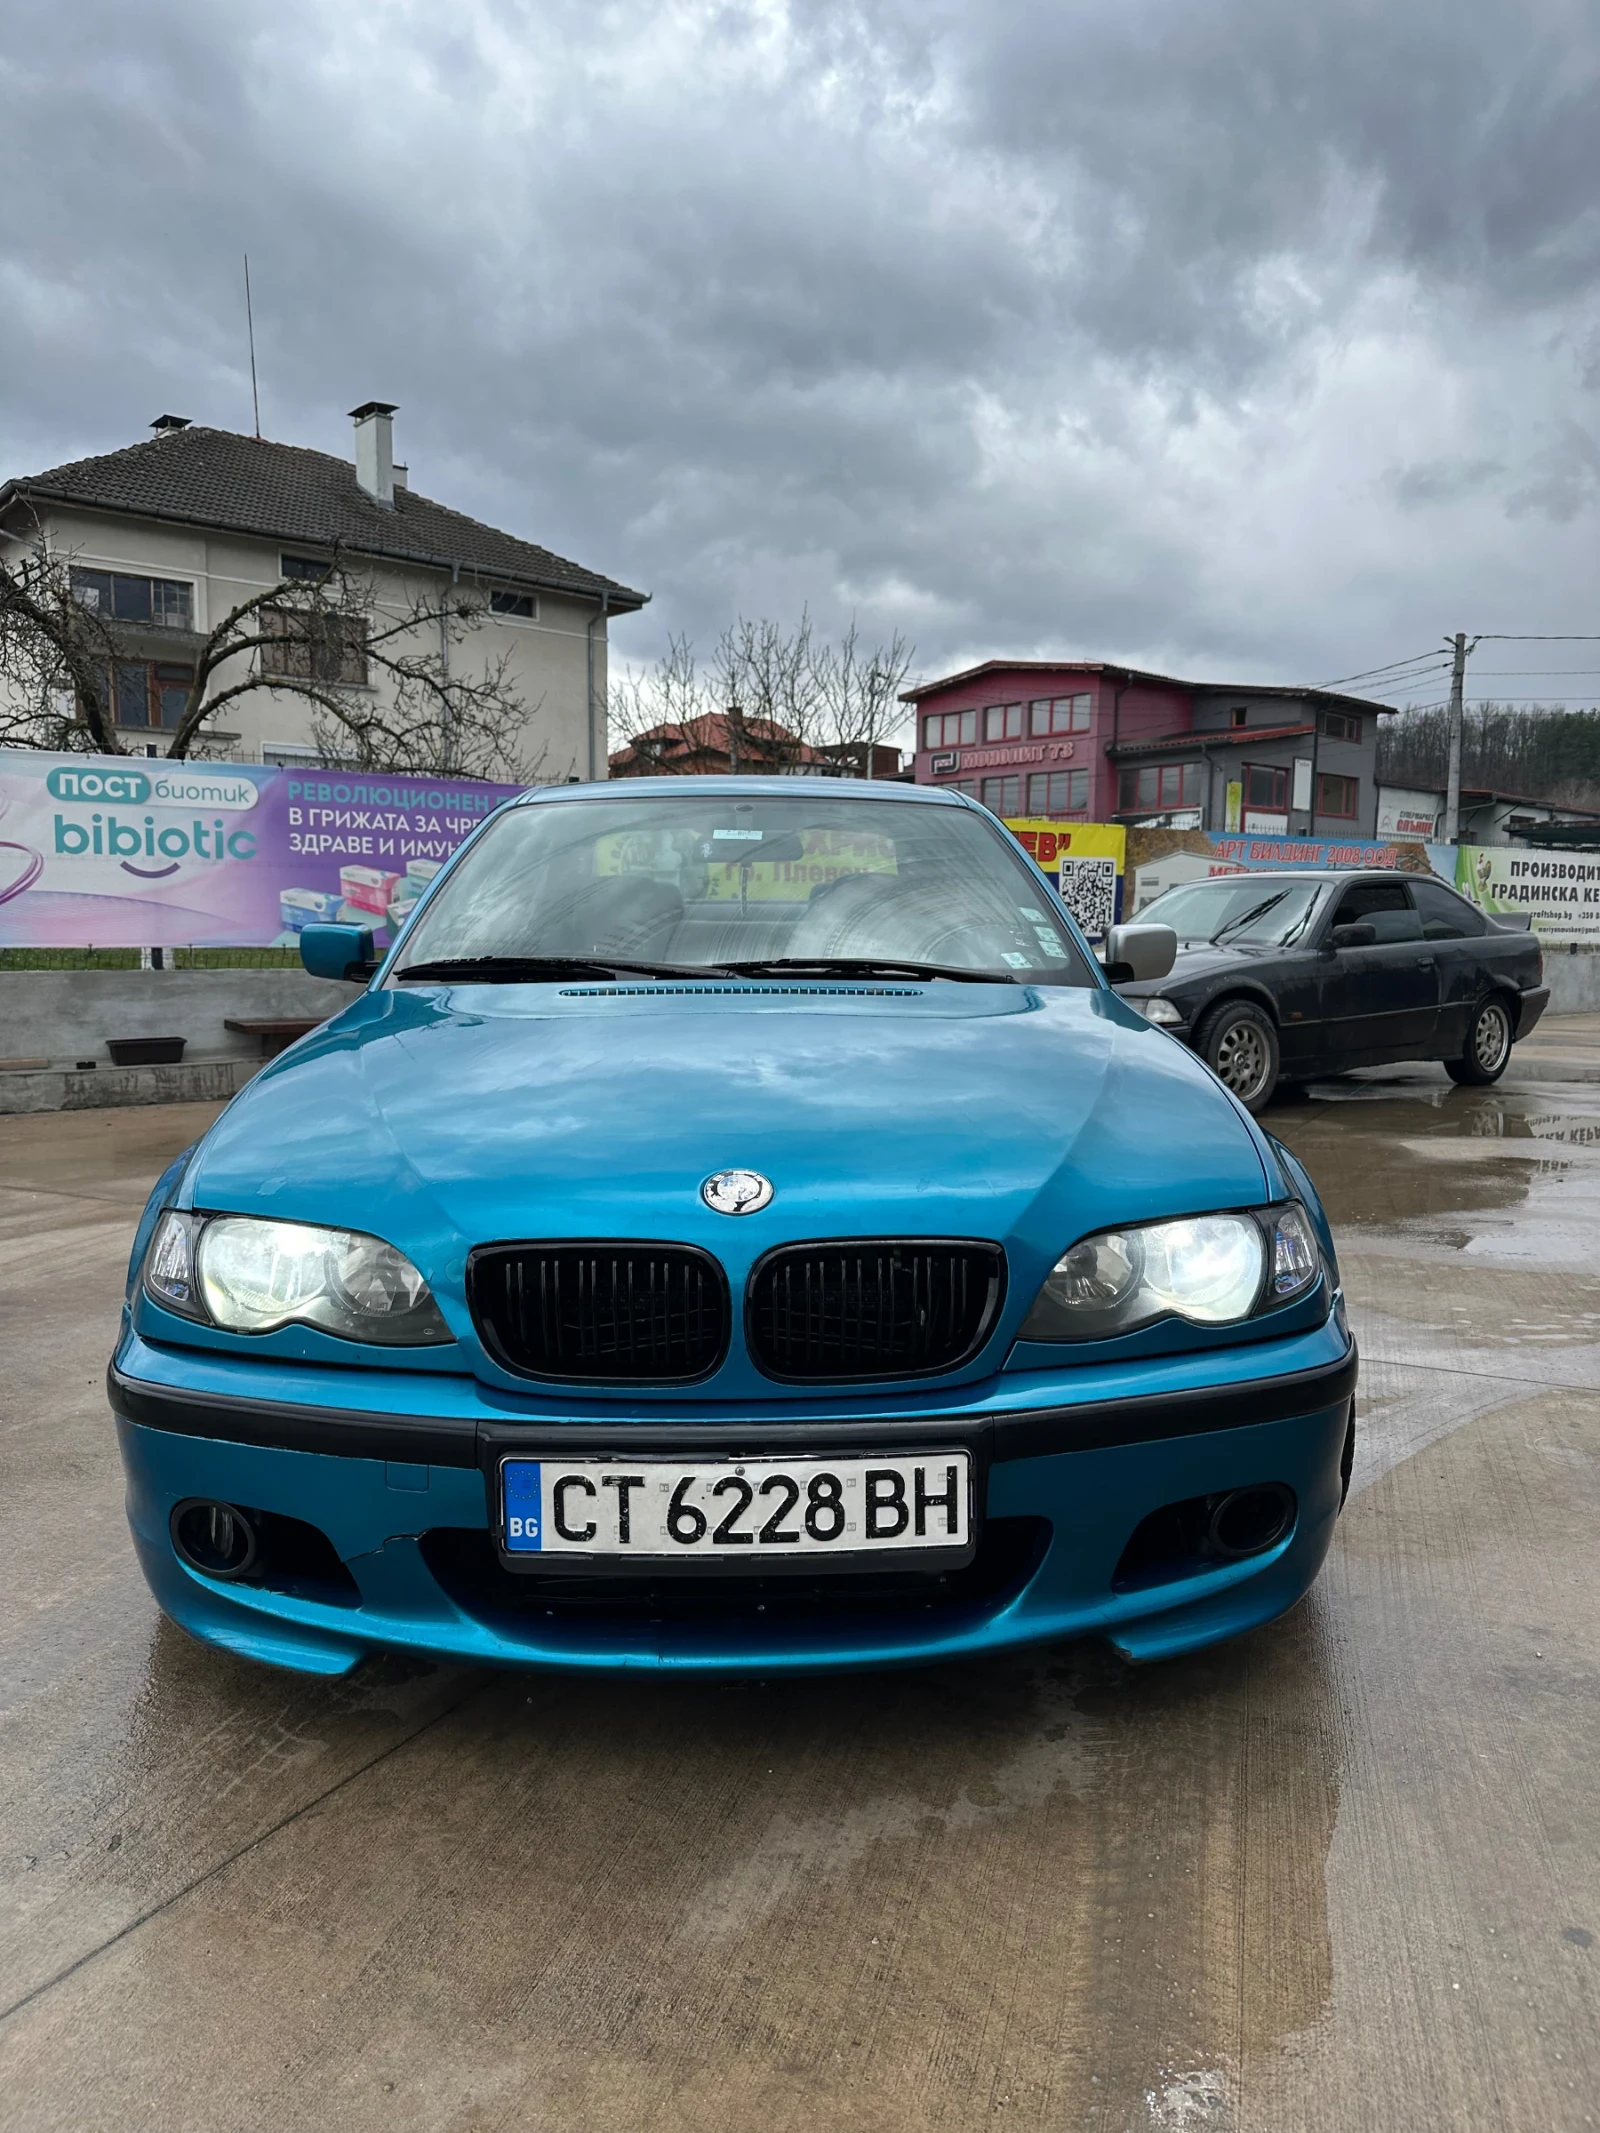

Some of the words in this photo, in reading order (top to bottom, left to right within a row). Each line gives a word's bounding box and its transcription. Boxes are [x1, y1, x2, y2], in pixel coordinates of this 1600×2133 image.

[962, 746, 1044, 769] МОНОЛИТ
[1049, 741, 1074, 760] 73
[287, 780, 490, 813] РЕВОЛЮЦИОНЕН
[288, 807, 303, 826] В
[308, 808, 411, 832] ГРИЖАТА
[414, 814, 442, 834] ЗА
[54, 813, 257, 861] bibiotic
[288, 832, 374, 856] ЗДРАВЕ
[379, 838, 395, 856] И
[1213, 840, 1248, 859] АРТ
[1250, 842, 1324, 864] БИЛДИНГ
[1326, 845, 1361, 864] 2008
[1364, 847, 1398, 869] ООД
[1491, 883, 1579, 903] ГРАДИНСКА
[509, 1517, 539, 1538] BG
[553, 1474, 646, 1544] CT
[666, 1474, 846, 1544] 6228
[865, 1465, 958, 1540] BH
